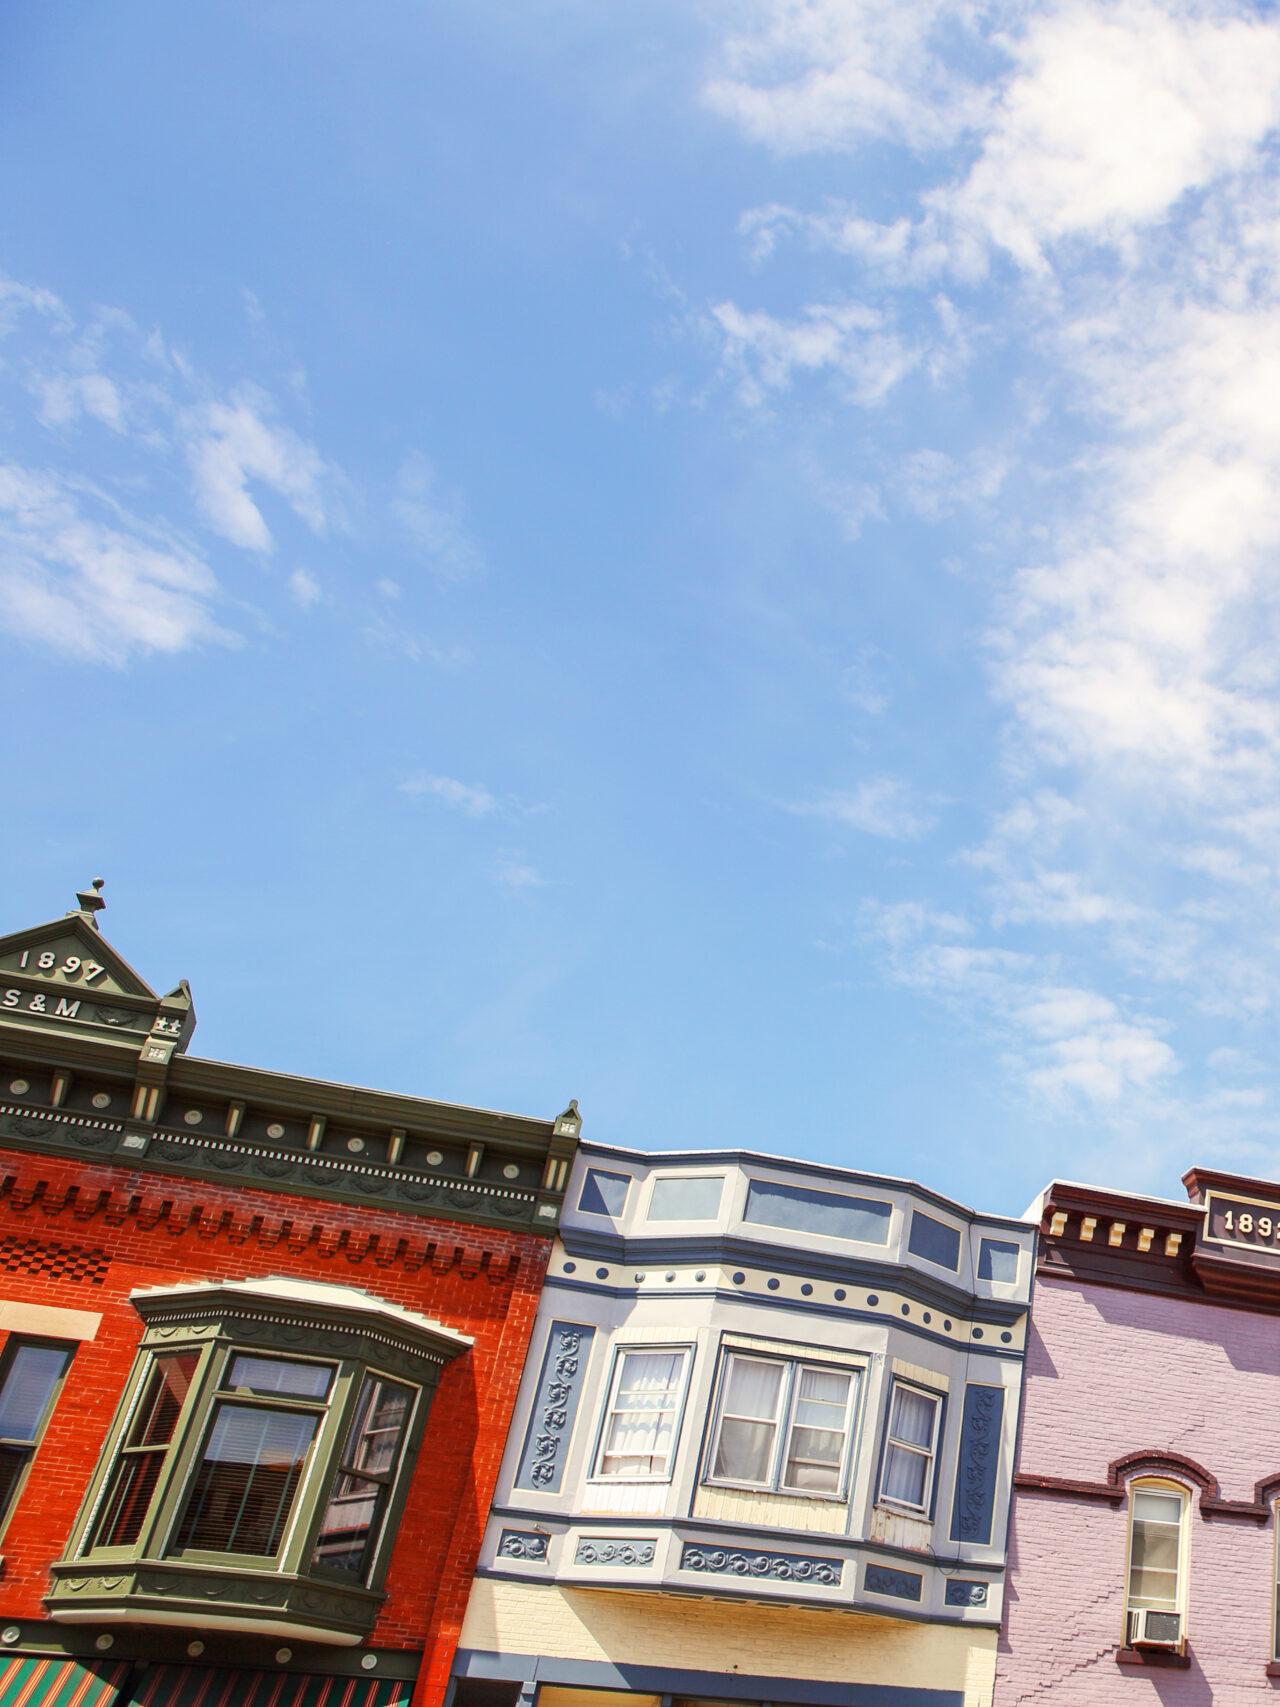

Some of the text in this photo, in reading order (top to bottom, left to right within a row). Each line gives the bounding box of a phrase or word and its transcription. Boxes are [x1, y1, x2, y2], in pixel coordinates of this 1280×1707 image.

[20, 950, 105, 981] 1897
[4, 989, 81, 1018] S & M
